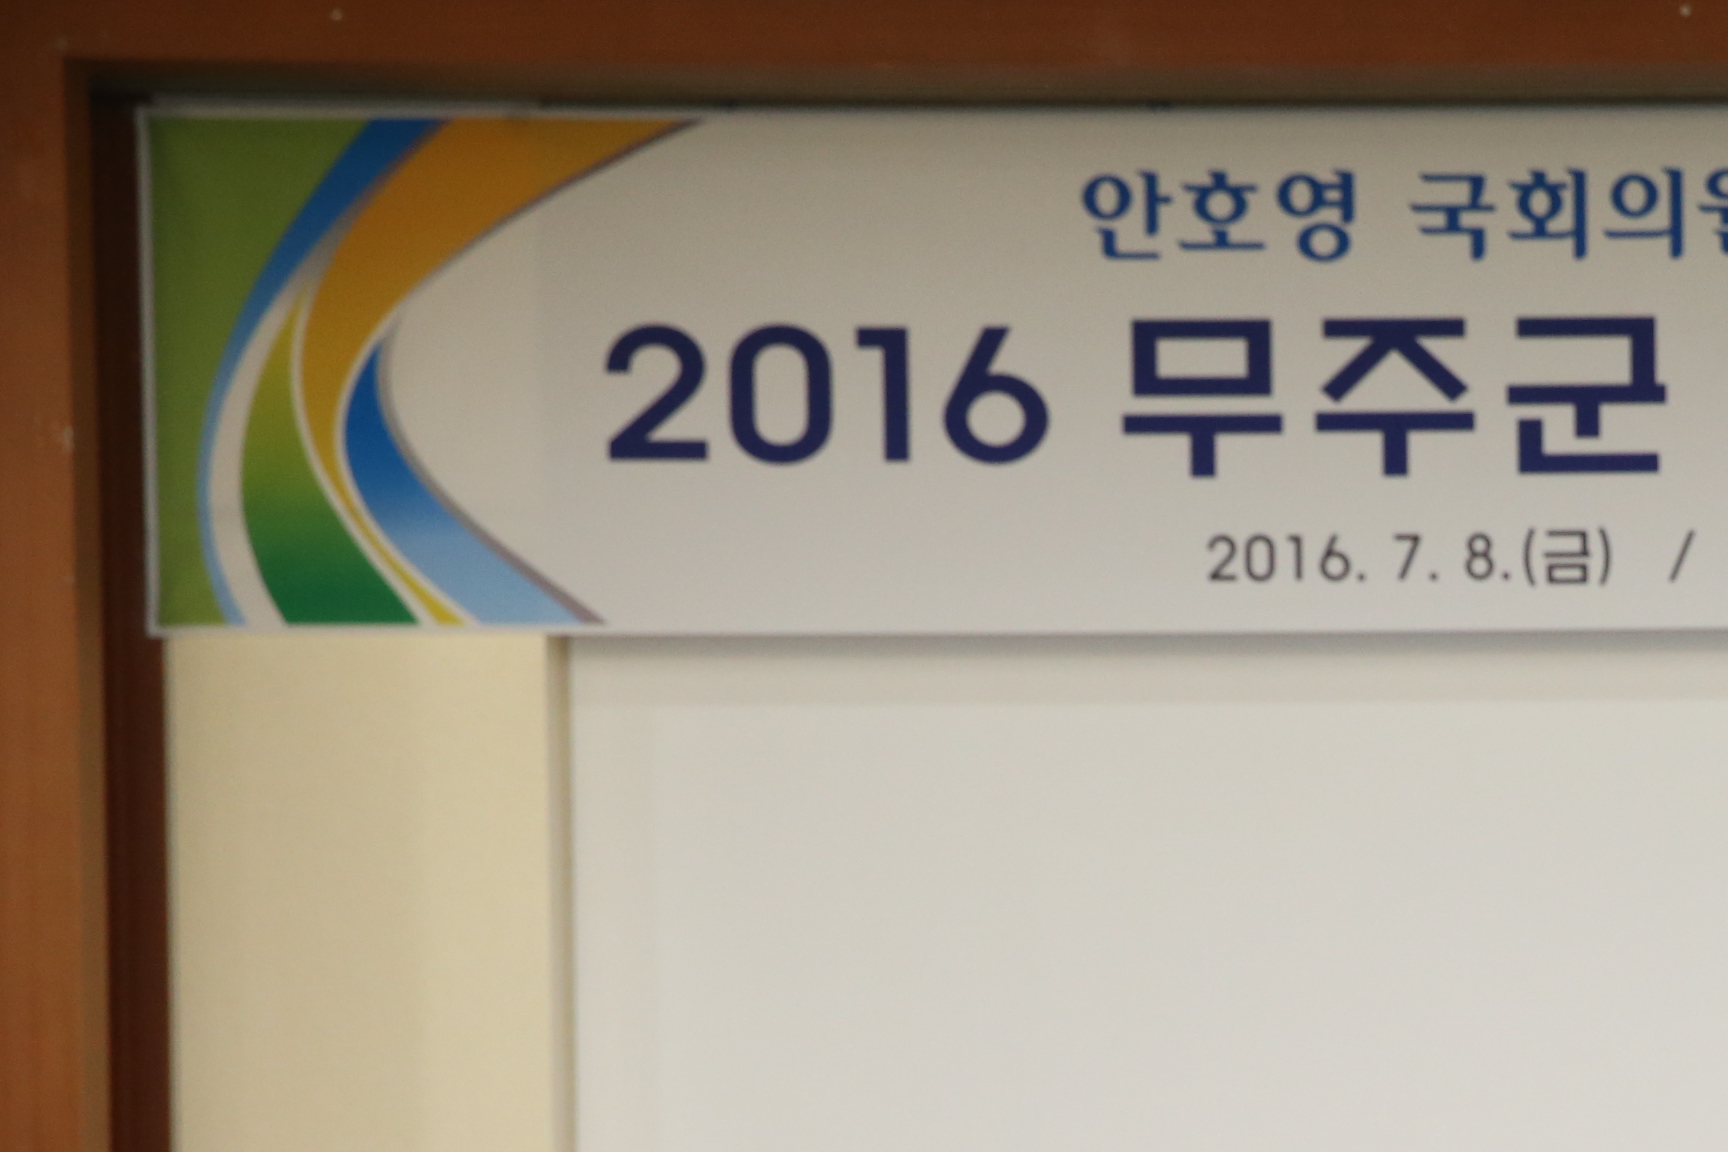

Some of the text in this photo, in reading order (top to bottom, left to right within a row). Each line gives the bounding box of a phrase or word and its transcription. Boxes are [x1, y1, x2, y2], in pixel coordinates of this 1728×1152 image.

[1081, 169, 1356, 262] 안호영
[604, 322, 1051, 466] 2016
[1122, 315, 1667, 478] 무주군
[1207, 535, 1366, 583] 2016.
[1394, 534, 1439, 581] 7.
[1464, 528, 1613, 586] 8.(금)
